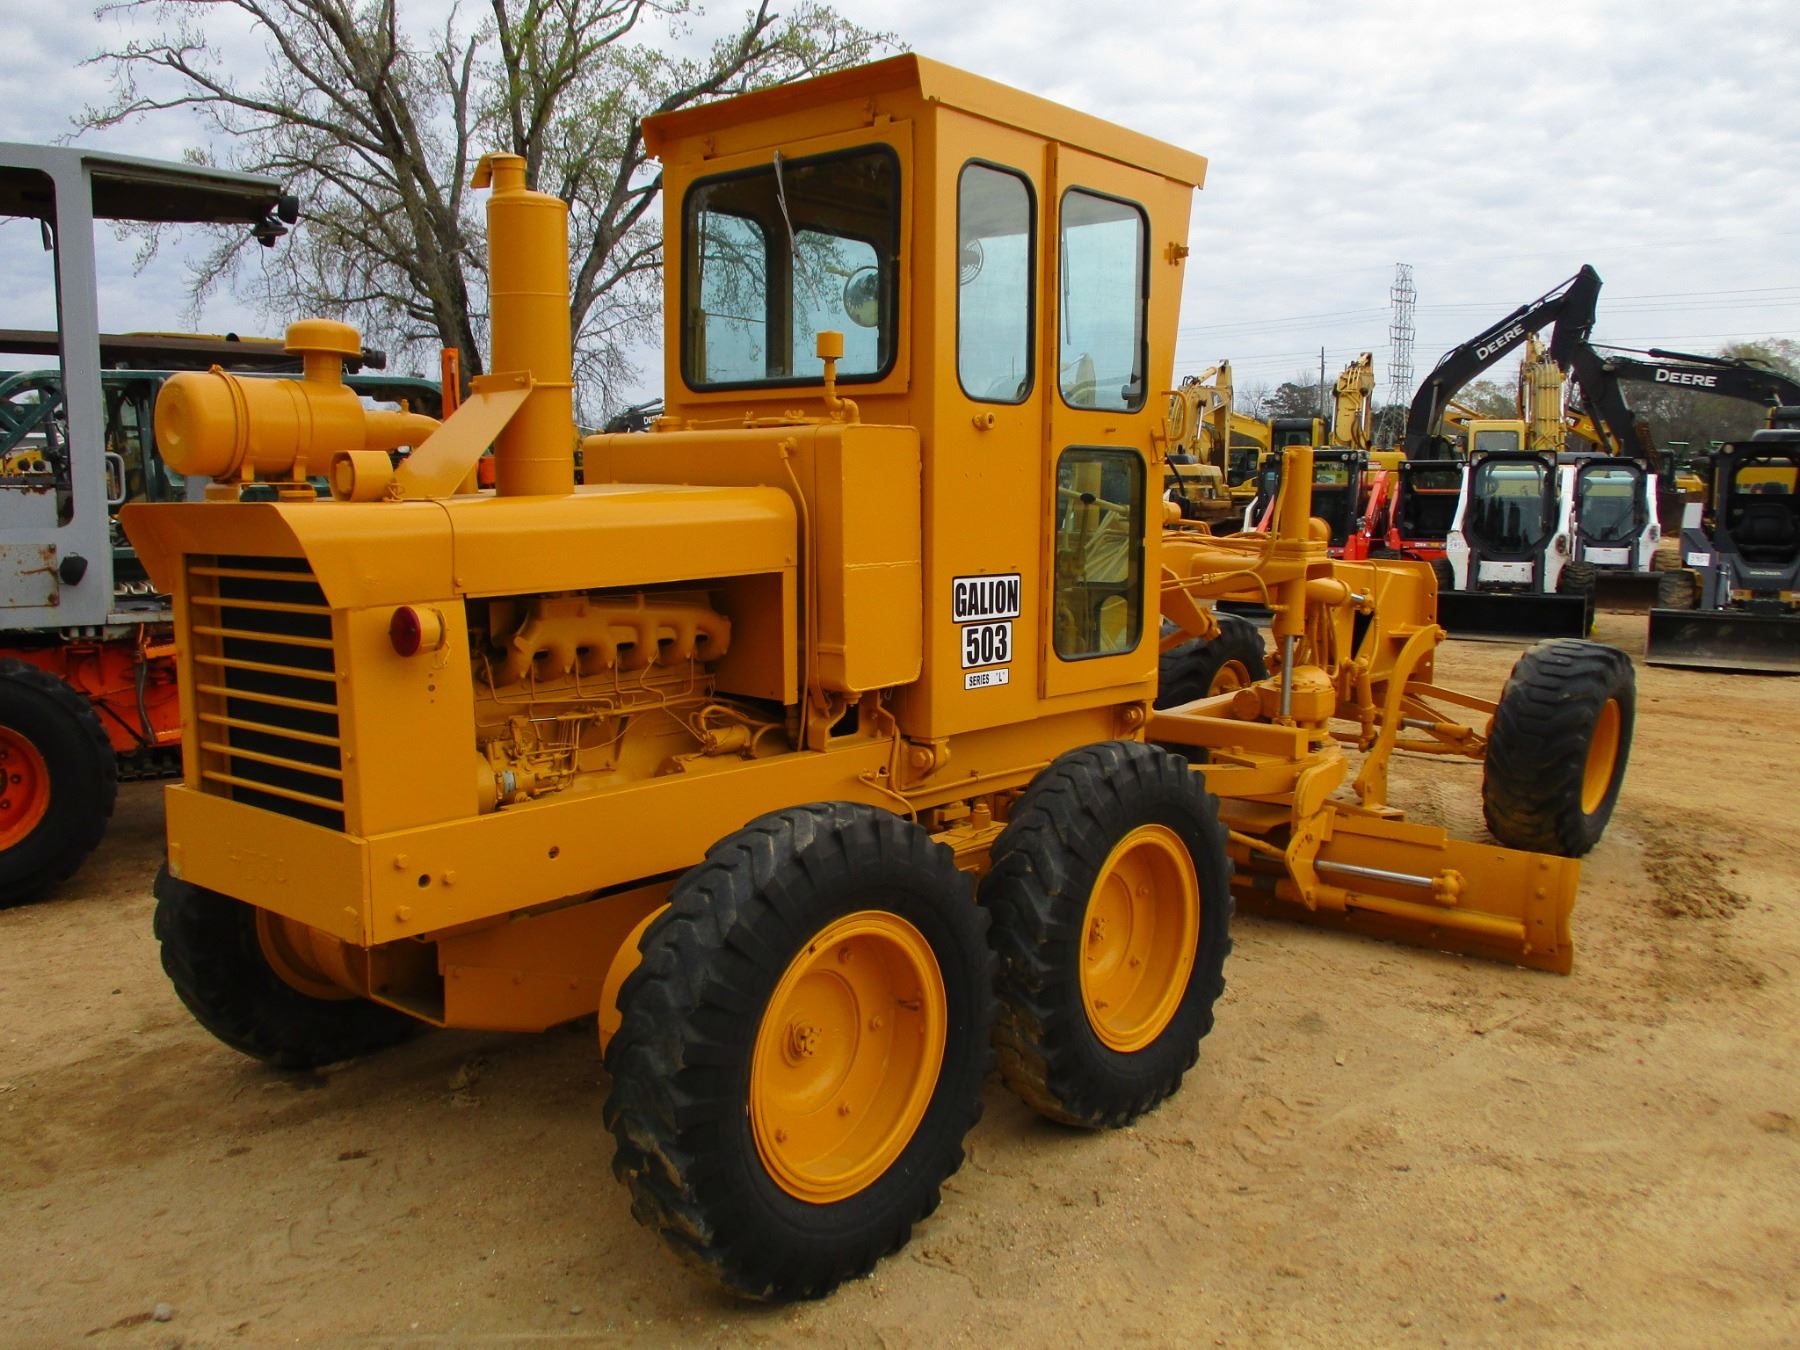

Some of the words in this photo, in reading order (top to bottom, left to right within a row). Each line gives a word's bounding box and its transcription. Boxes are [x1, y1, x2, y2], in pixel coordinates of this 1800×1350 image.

[1476, 323, 1525, 361] DEERE
[1655, 368, 1718, 387] DEERE
[955, 579, 1018, 618] GALION
[966, 624, 1007, 665] 503
[968, 674, 990, 687] SERIES
